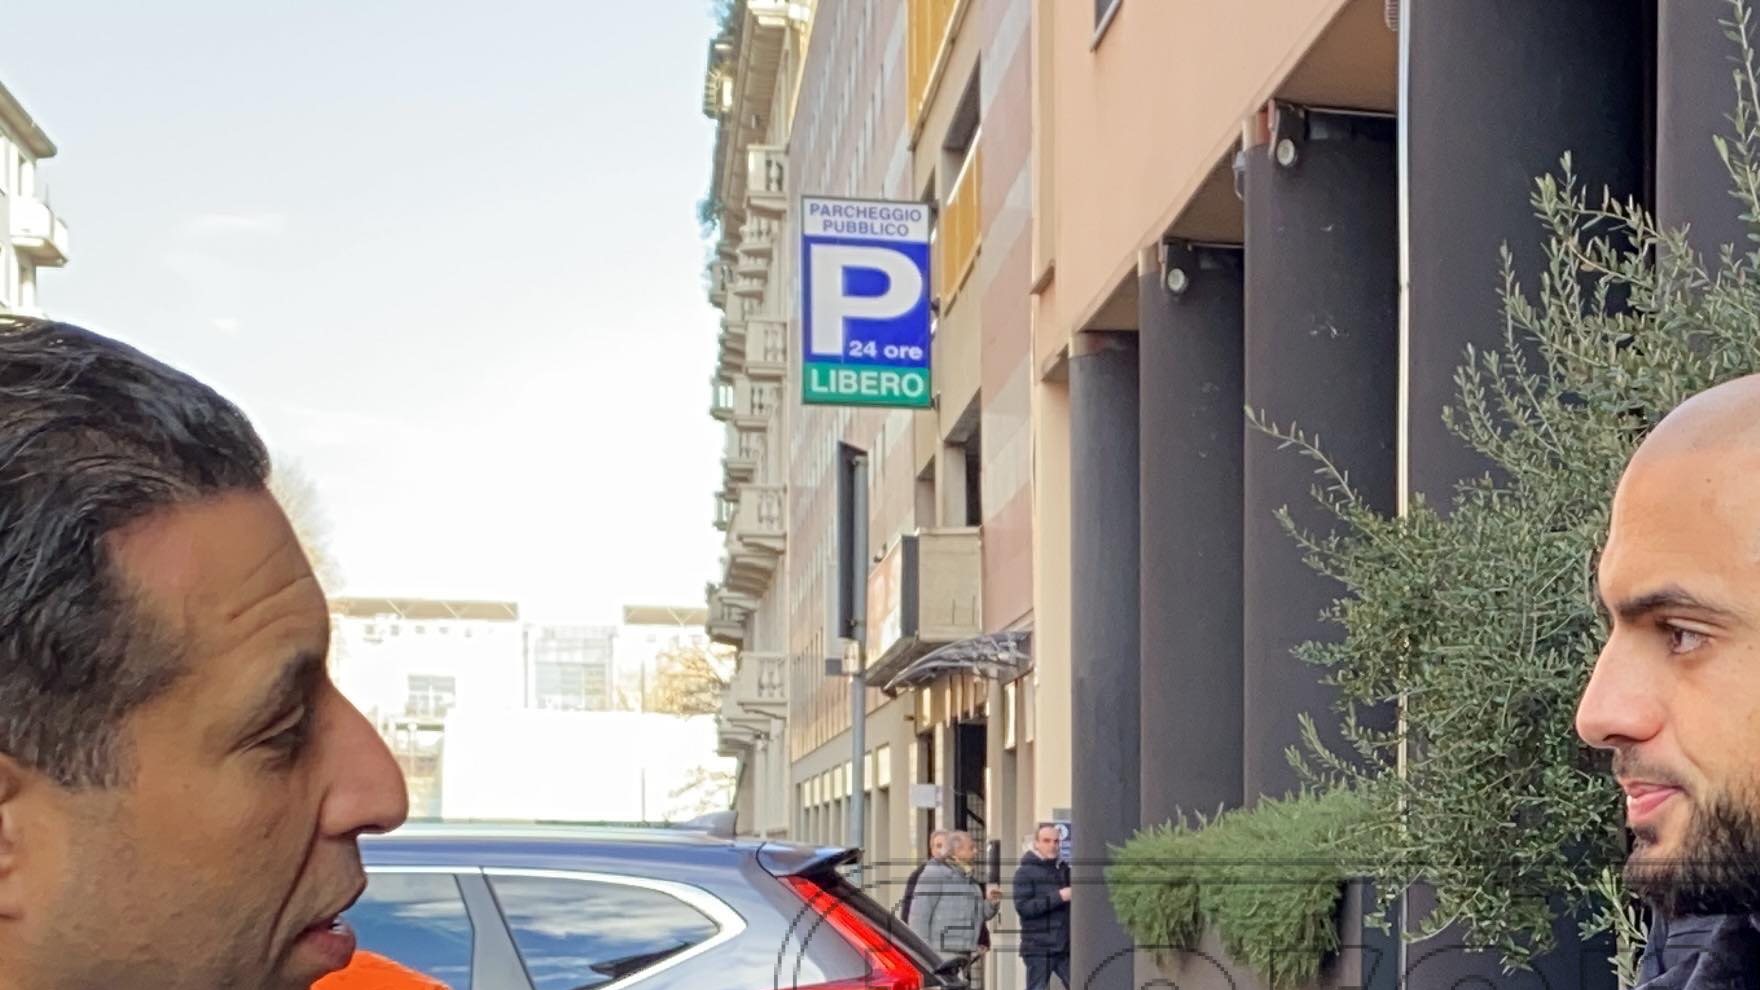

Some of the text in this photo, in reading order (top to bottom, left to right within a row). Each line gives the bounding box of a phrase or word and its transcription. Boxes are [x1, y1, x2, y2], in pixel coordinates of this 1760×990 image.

[809, 203, 922, 222] PARCHEGGIO
[822, 219, 910, 237] PUBBLICO
[810, 243, 923, 356] P
[849, 340, 924, 361] 24 ore
[810, 369, 925, 398] LIBERO
